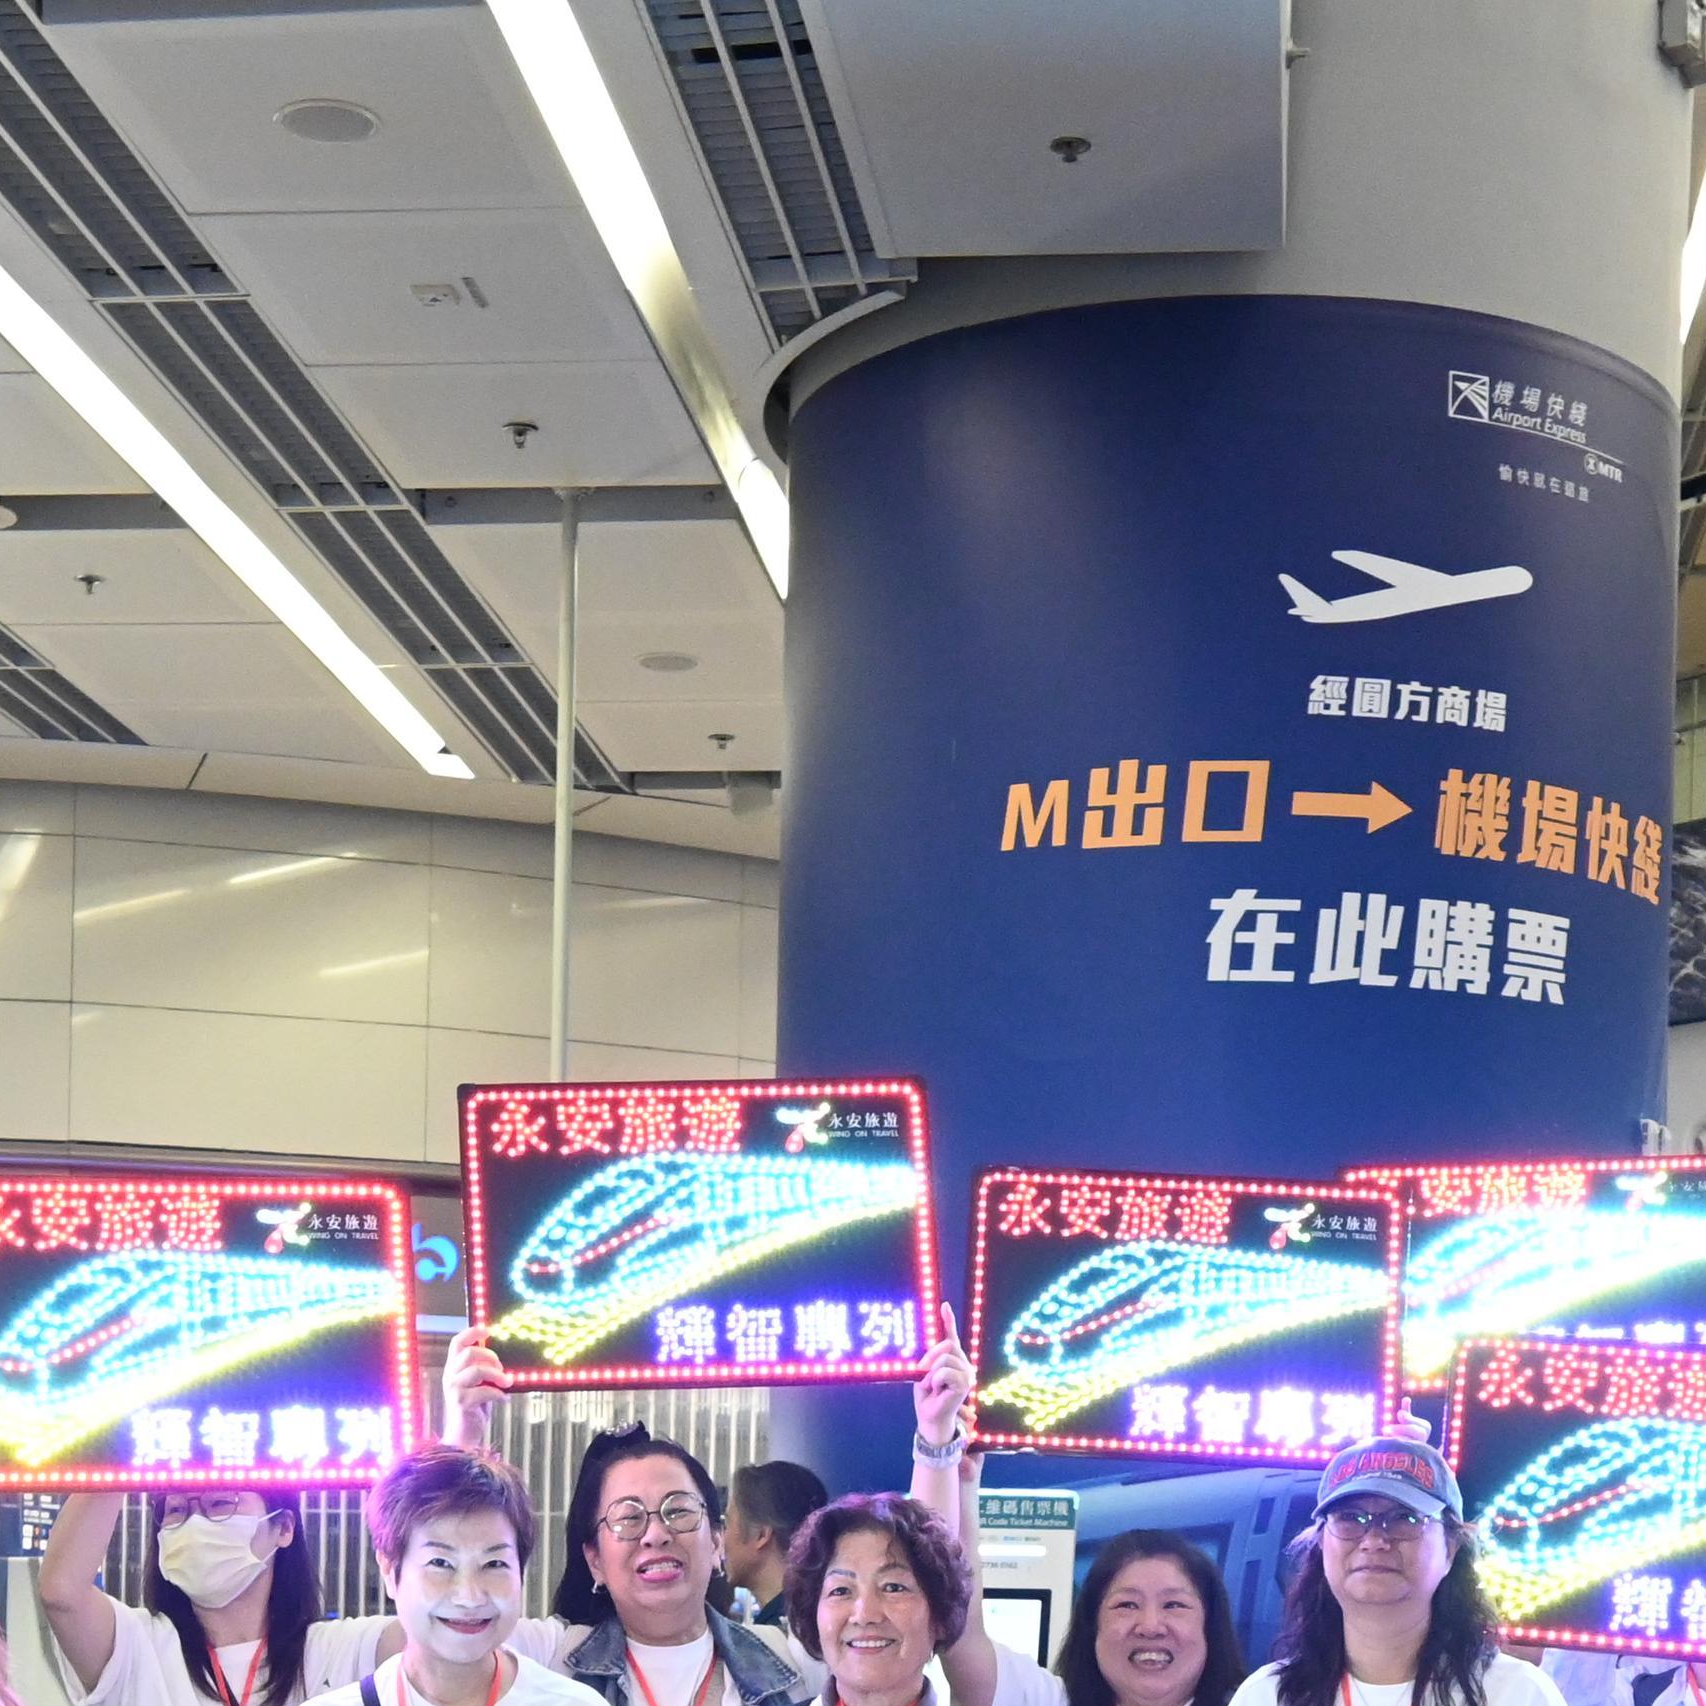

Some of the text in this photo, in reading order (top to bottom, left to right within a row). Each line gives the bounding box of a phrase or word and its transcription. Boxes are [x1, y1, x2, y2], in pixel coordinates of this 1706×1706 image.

[1491, 406, 1586, 444] Airport Express
[1598, 463, 1623, 483] MTR
[1434, 767, 1663, 906] 機場快綫
[1205, 888, 1571, 1006] 在此購票
[490, 1095, 744, 1158] 永安旅遊
[828, 1111, 899, 1129] 永安旅遊
[828, 1129, 899, 1138] WING ON TRAVEL
[1422, 1168, 1588, 1216] 安旅遊
[307, 1213, 379, 1231] 永安旅遊
[998, 1183, 1234, 1245] 永安旅遊
[1311, 1214, 1378, 1232] 永安旅遊
[308, 1231, 379, 1240] WING ON TRAVEL
[1335, 1231, 1347, 1239] ON
[656, 1300, 917, 1364] 輝智專列
[1359, 1452, 1434, 1489] ANGELES
